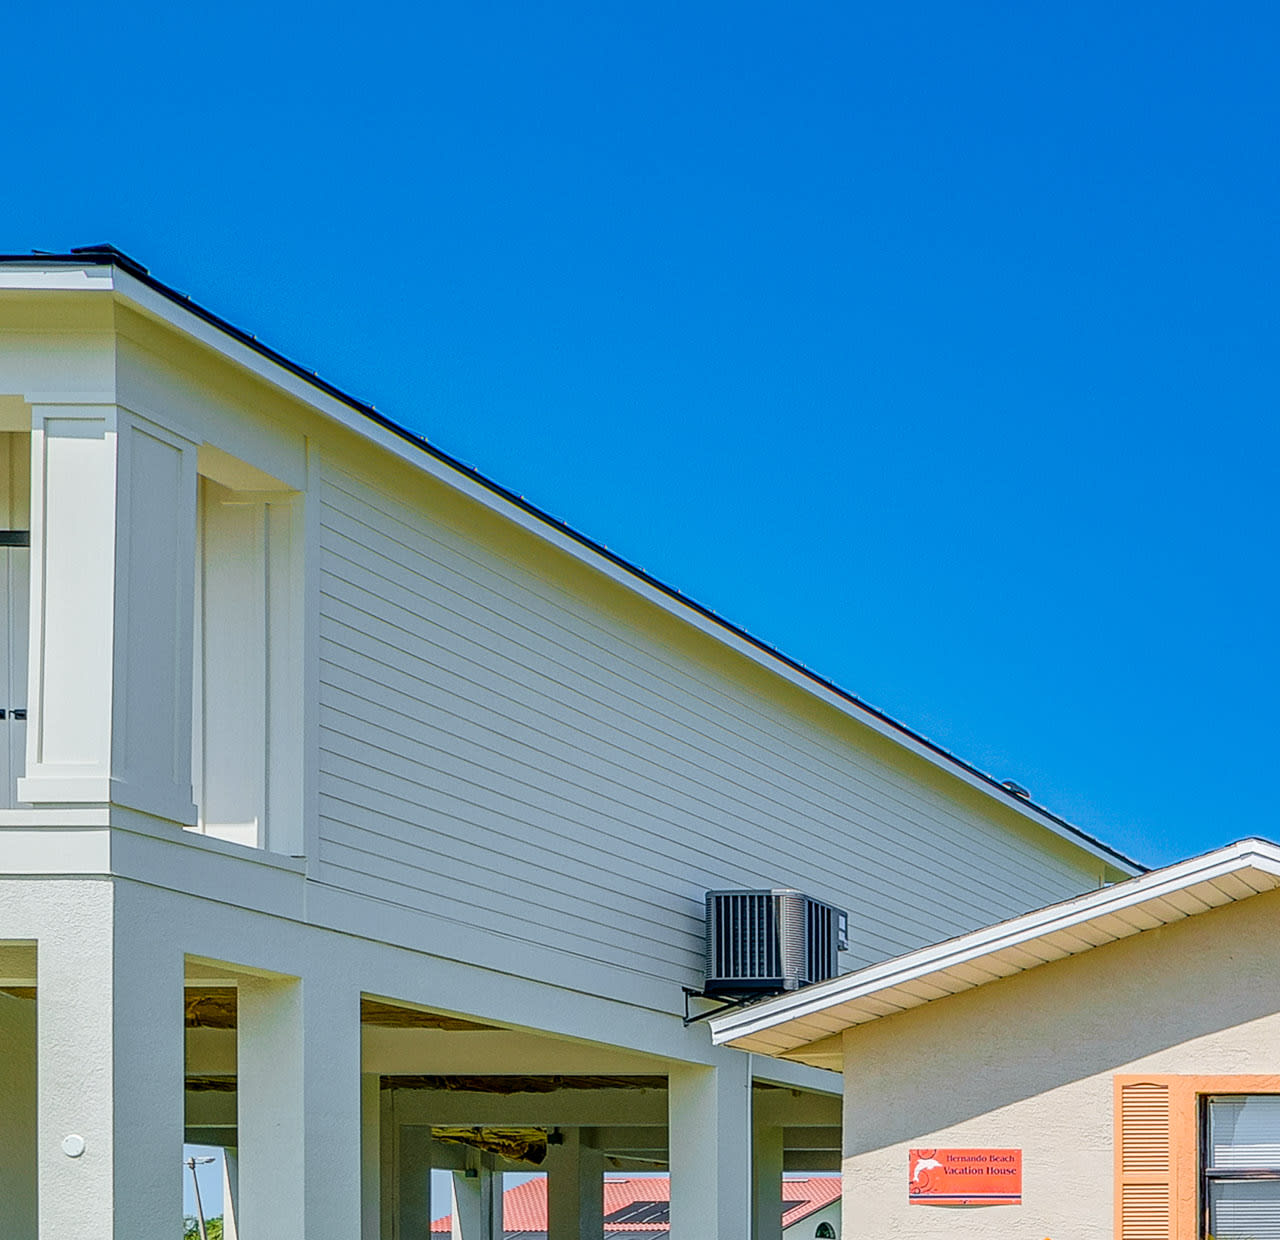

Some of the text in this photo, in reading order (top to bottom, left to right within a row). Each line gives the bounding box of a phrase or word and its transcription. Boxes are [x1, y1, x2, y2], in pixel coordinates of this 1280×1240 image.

[946, 1154, 1015, 1162] Hernando Beach
[943, 1166, 1017, 1175] Vacation House
